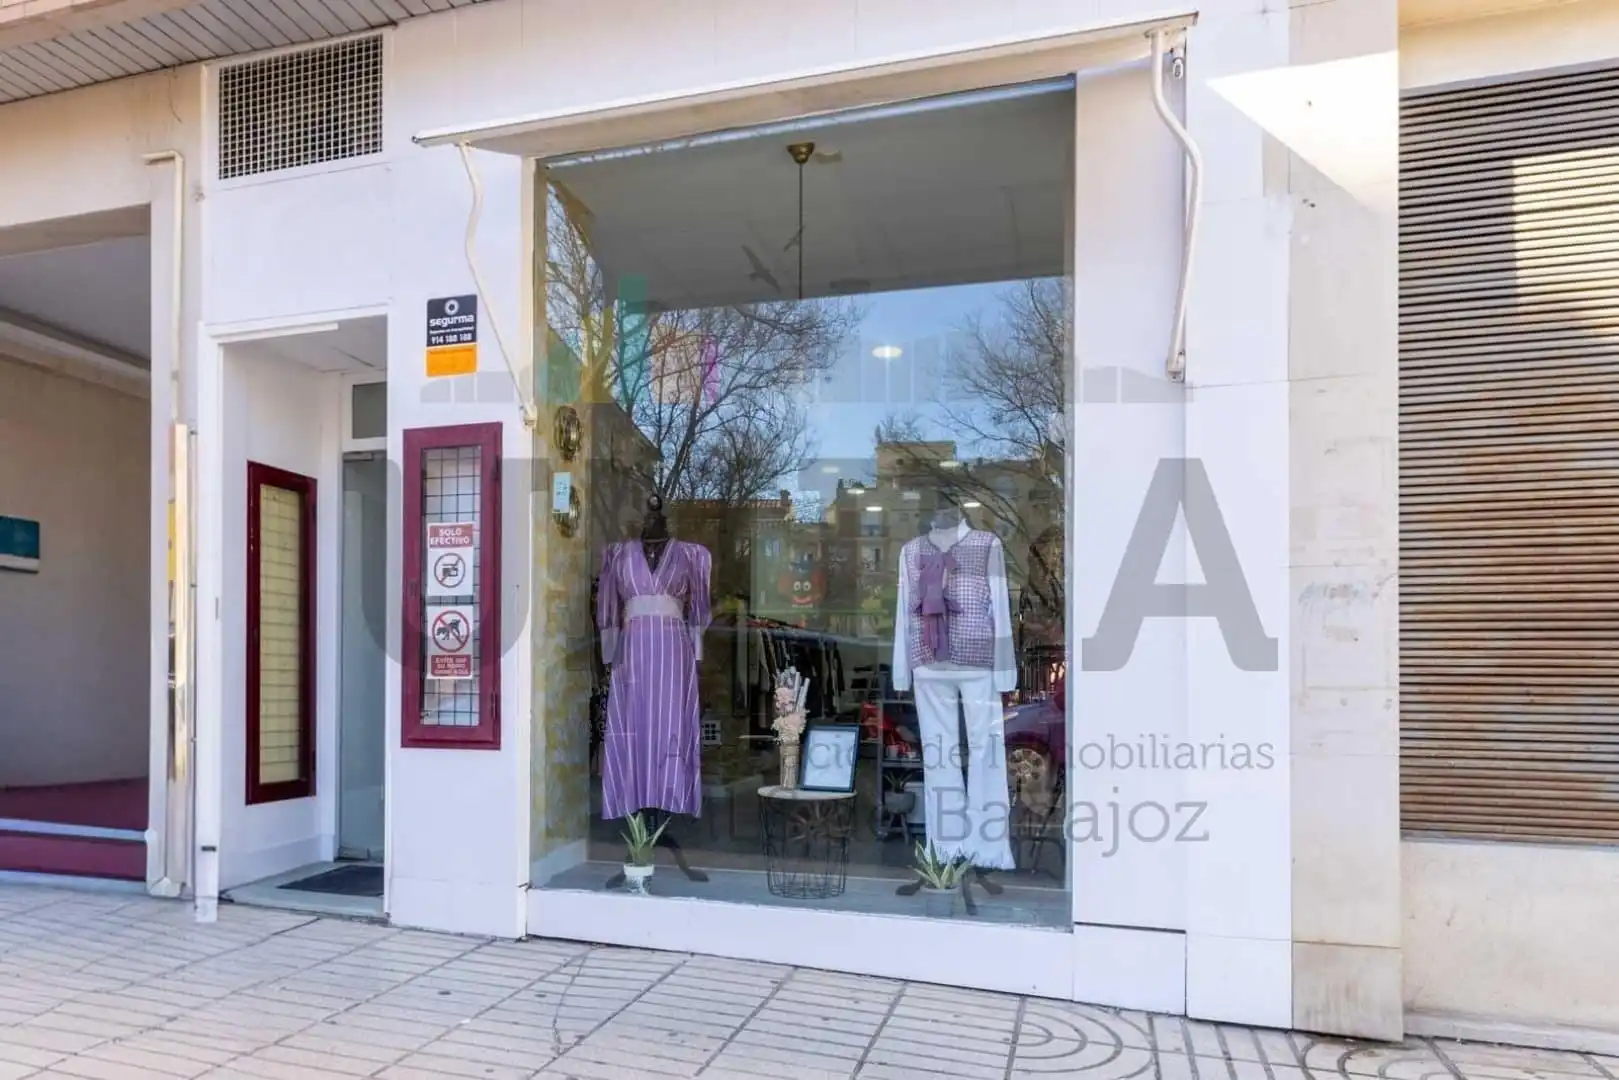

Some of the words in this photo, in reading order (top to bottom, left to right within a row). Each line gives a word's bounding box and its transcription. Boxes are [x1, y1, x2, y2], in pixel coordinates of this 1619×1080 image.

[429, 314, 474, 327] segurma
[439, 526, 463, 537] SOLO
[429, 535, 470, 546] EFECTIVO
